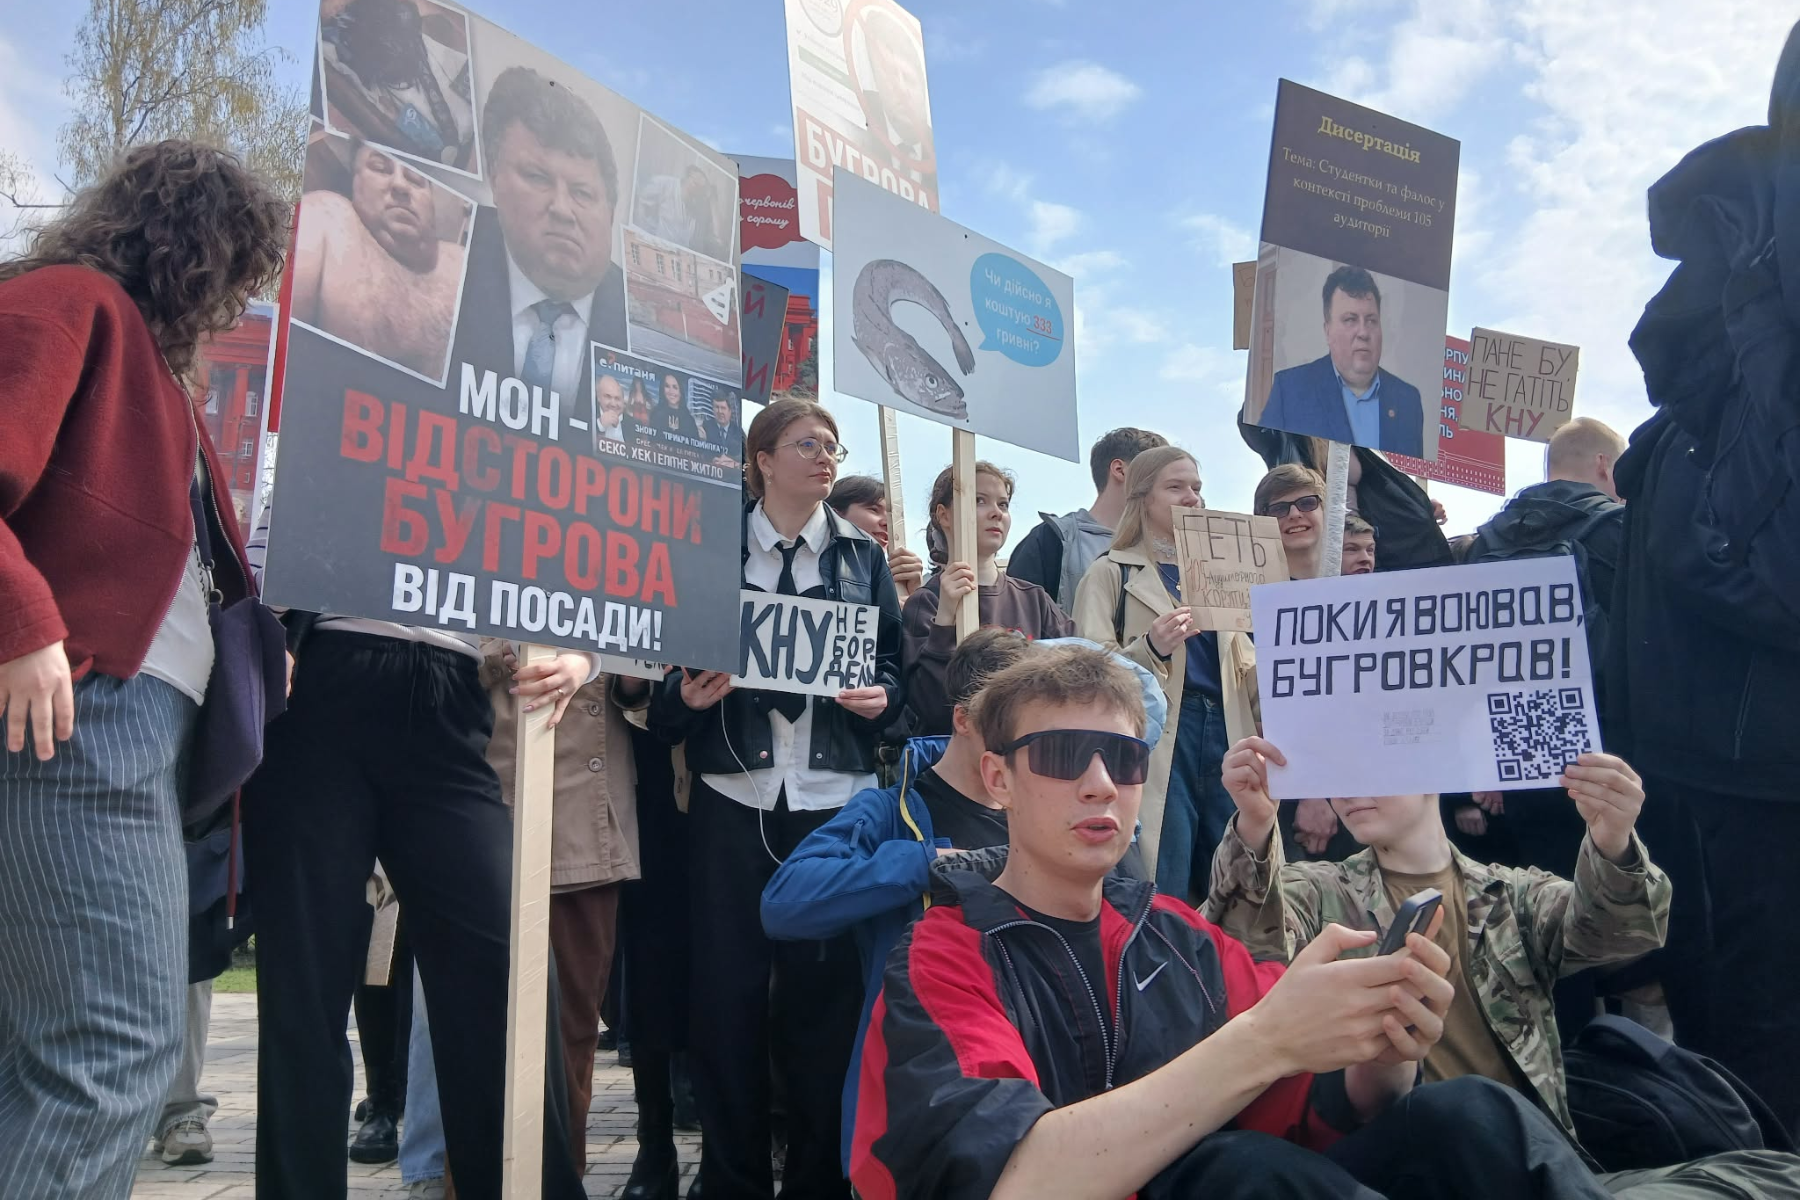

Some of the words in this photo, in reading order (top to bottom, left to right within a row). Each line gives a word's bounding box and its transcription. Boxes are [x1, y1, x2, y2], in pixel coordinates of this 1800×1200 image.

[1317, 115, 1421, 164] Дисертація
[1283, 146, 1316, 170] Тема:
[1319, 159, 1383, 190] Студентки
[1385, 183, 1398, 195] та
[1400, 185, 1436, 207] фалос
[1438, 199, 1445, 211] у
[740, 195, 795, 210] червонів
[747, 215, 789, 229] сорому
[1293, 177, 1350, 203] контексті
[1354, 194, 1411, 222] проблеми
[1414, 212, 1432, 227] 105
[1334, 211, 1390, 238] аудиторії
[985, 267, 1001, 287] Чи
[1004, 279, 1042, 304] дійсно
[985, 297, 1031, 325] коштую
[1033, 315, 1052, 334] 333
[996, 328, 1040, 354] гривні?
[1471, 336, 1526, 370] ПАНЕ
[459, 363, 560, 440] МОН
[1467, 367, 1499, 401] НЕ
[1504, 373, 1569, 412] ГАТІТЬ
[635, 424, 657, 436] ЗНОВУ
[1486, 402, 1544, 437] КНУ
[340, 388, 703, 545] ВІДСТОРОНИ
[599, 439, 629, 460] СЕКС,
[631, 447, 651, 463] ХЕК
[653, 451, 657, 463] І
[658, 452, 689, 472] ЕЛІТНЕ
[691, 460, 723, 479] ЖИТЛО
[380, 477, 676, 607] БУГРОВА
[1183, 514, 1266, 568] ГЕТЬ
[392, 562, 477, 629] ВІД
[490, 579, 662, 653] ПОСАДИ!
[836, 605, 868, 634] НЕ
[1275, 600, 1377, 646] ПОКИ
[1386, 598, 1405, 639] Я
[1415, 583, 1583, 635] ВОЮВАВ,
[739, 601, 833, 685] КНУ
[1272, 648, 1433, 698] БУГРОВ
[1440, 638, 1570, 687] КРАВ!
